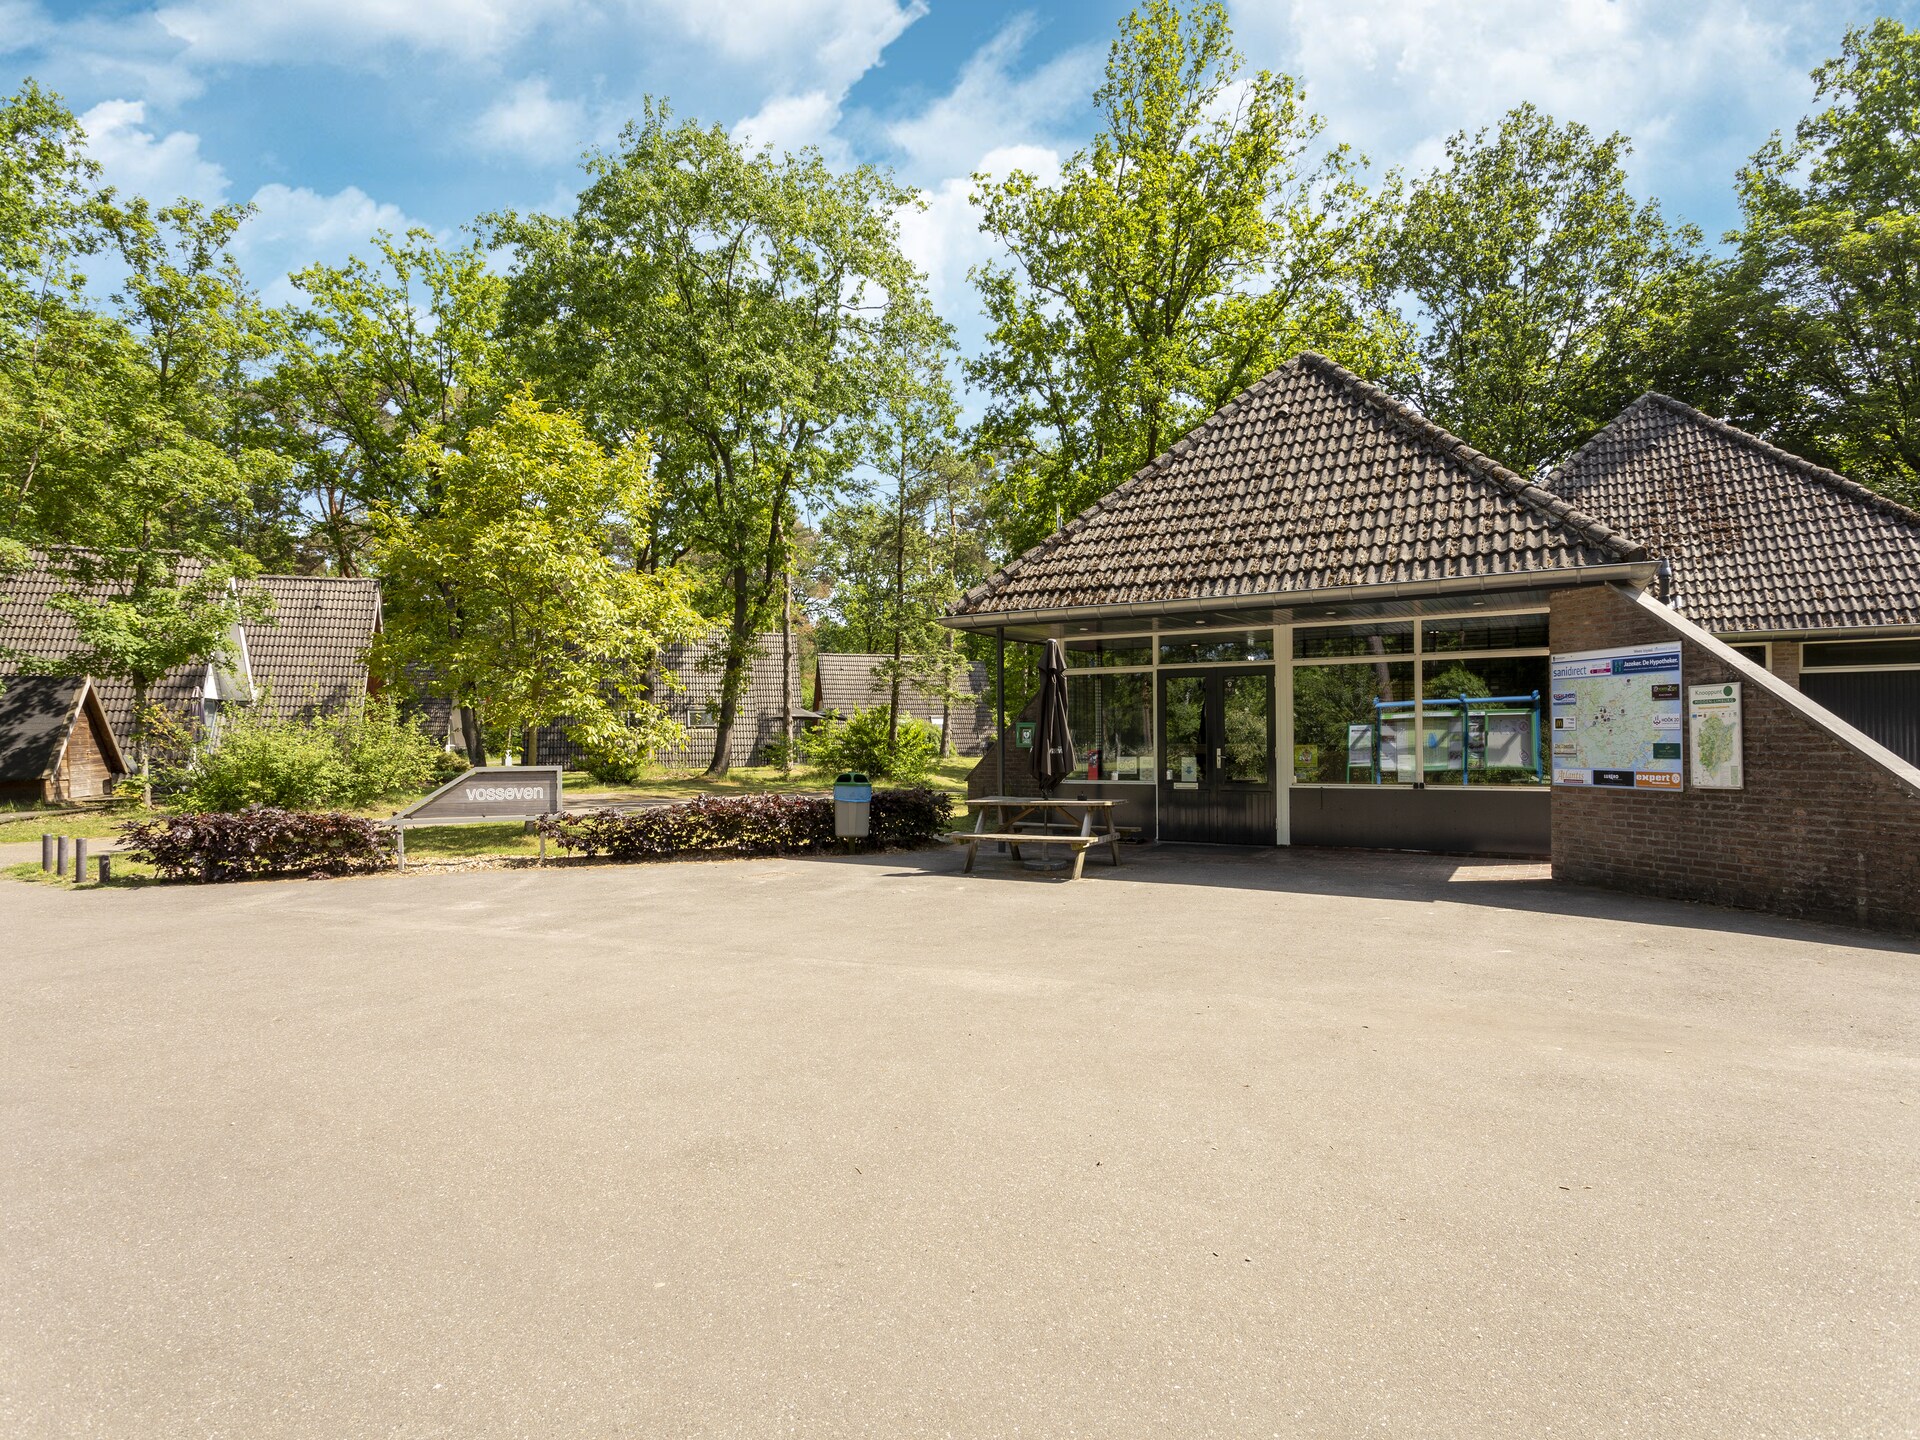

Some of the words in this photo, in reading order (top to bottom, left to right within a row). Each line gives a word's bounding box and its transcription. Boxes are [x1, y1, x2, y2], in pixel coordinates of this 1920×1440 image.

[1650, 657, 1679, 666] Hypotheker.
[1553, 666, 1587, 677] sanidirect
[1556, 770, 1584, 781] Atlantis
[1636, 774, 1670, 782] expert
[465, 786, 544, 801] vosseven
